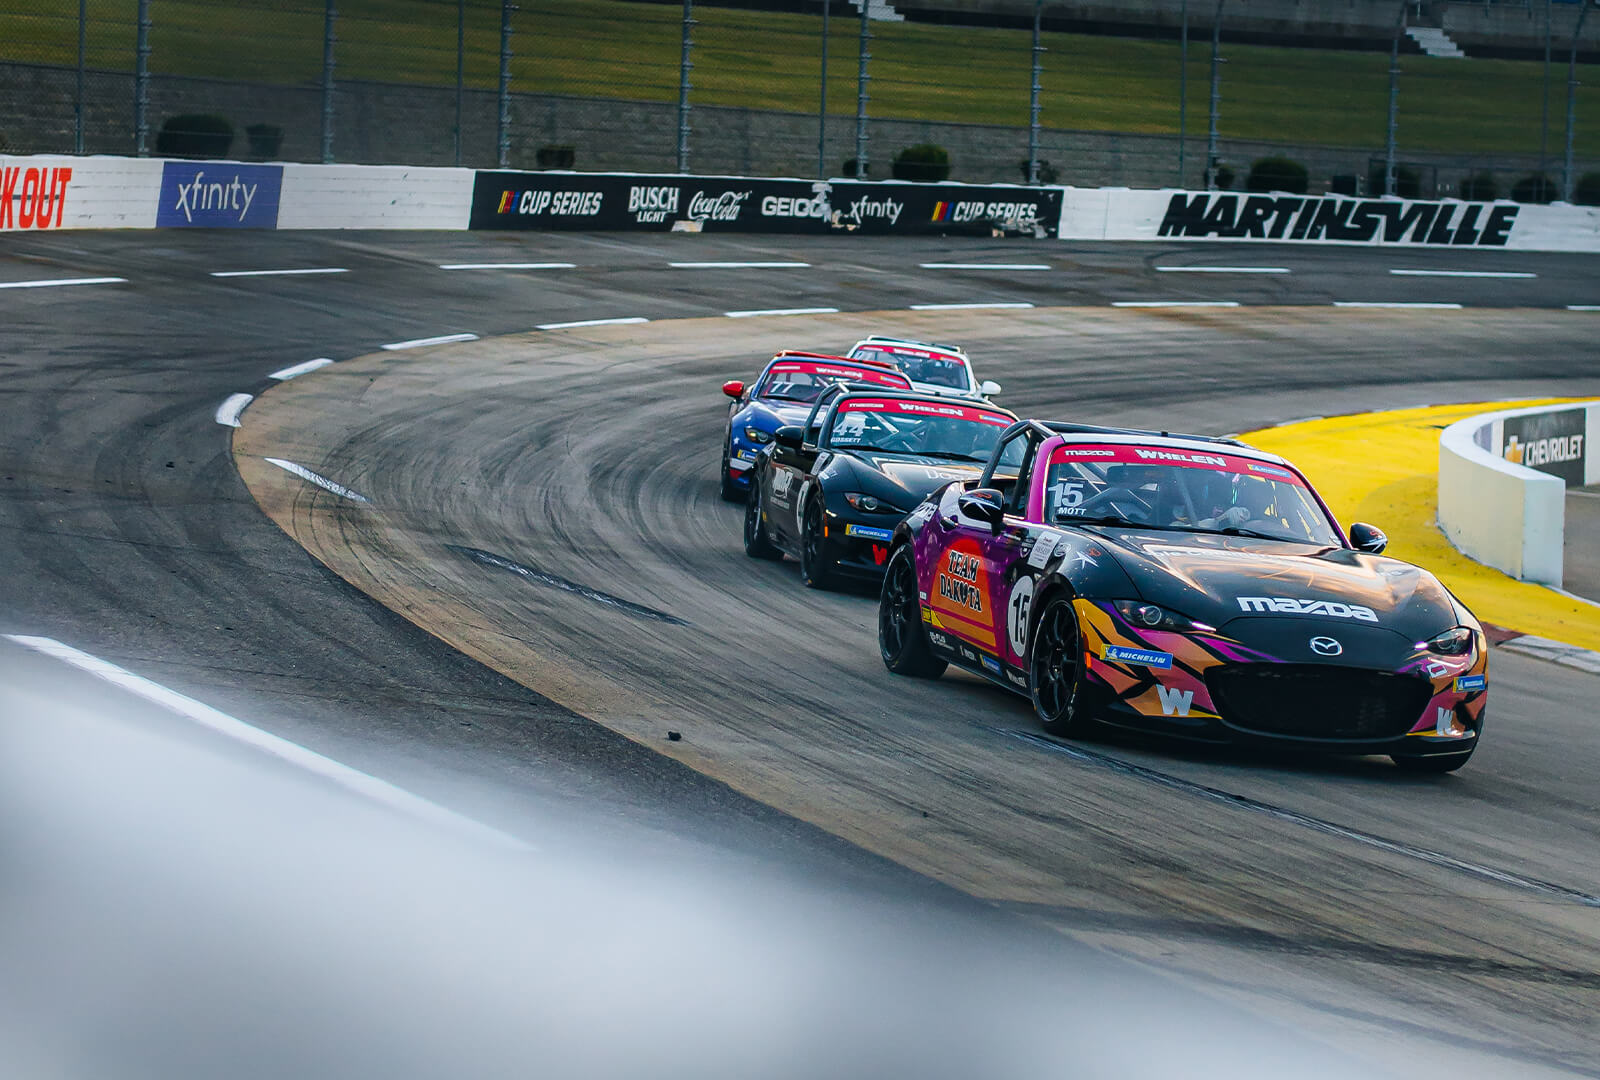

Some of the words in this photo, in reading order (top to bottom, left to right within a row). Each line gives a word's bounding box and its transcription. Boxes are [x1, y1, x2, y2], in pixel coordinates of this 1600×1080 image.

[19, 167, 72, 229] OUT
[175, 171, 258, 223] xfinity
[519, 190, 550, 215] CUP
[550, 191, 603, 215] SERIES
[628, 186, 679, 213] BUSCH
[850, 195, 904, 225] xfinity
[637, 211, 667, 222] LIGHT
[953, 201, 985, 222] CUP
[986, 203, 1038, 223] SERIES
[1157, 193, 1520, 246] MARTINSVILLE
[771, 381, 795, 394] 77
[899, 402, 964, 417] WHELEN
[833, 419, 866, 437] 44
[1135, 448, 1227, 467] WHELEN
[1525, 434, 1583, 466] CHEVROLET
[1048, 482, 1084, 508] 15
[1057, 507, 1087, 516] MOTT
[948, 549, 980, 583] TEAM
[940, 573, 982, 613] DAKOTA
[1012, 592, 1031, 645] 15
[1236, 596, 1379, 622] mazda
[1118, 651, 1166, 664] MICHELIN
[1156, 683, 1194, 716] W
